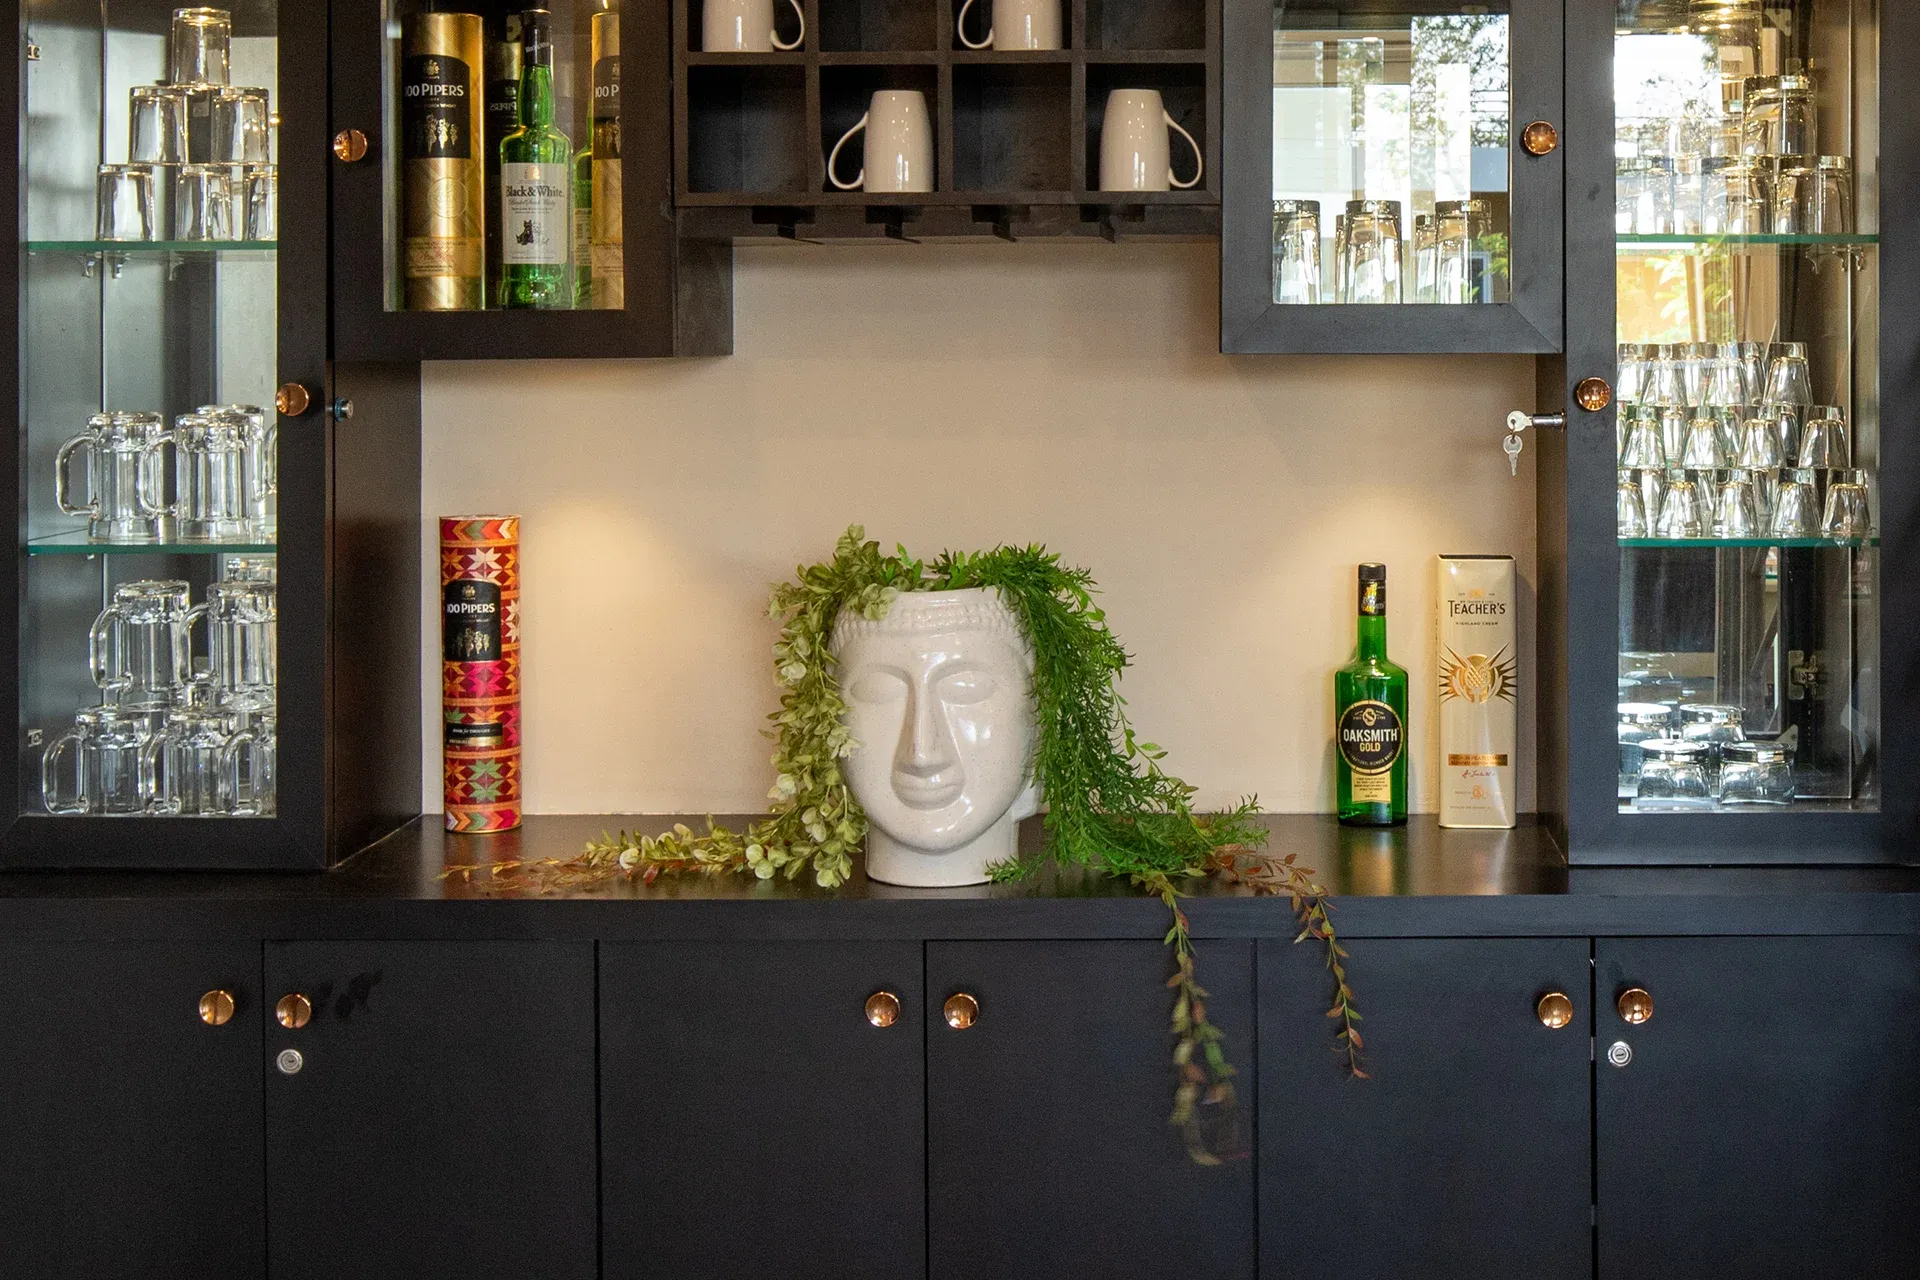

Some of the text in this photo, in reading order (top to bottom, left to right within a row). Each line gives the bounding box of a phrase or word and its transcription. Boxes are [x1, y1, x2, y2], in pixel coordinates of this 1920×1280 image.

[421, 83, 464, 96] PIPERS
[595, 86, 609, 98] 100
[506, 185, 562, 197] Black & White
[447, 603, 495, 614] 100 PIPERS
[1447, 600, 1506, 617] TEACHER'S
[1343, 728, 1398, 742] OAKSMITH
[1360, 742, 1381, 752] GOLD
